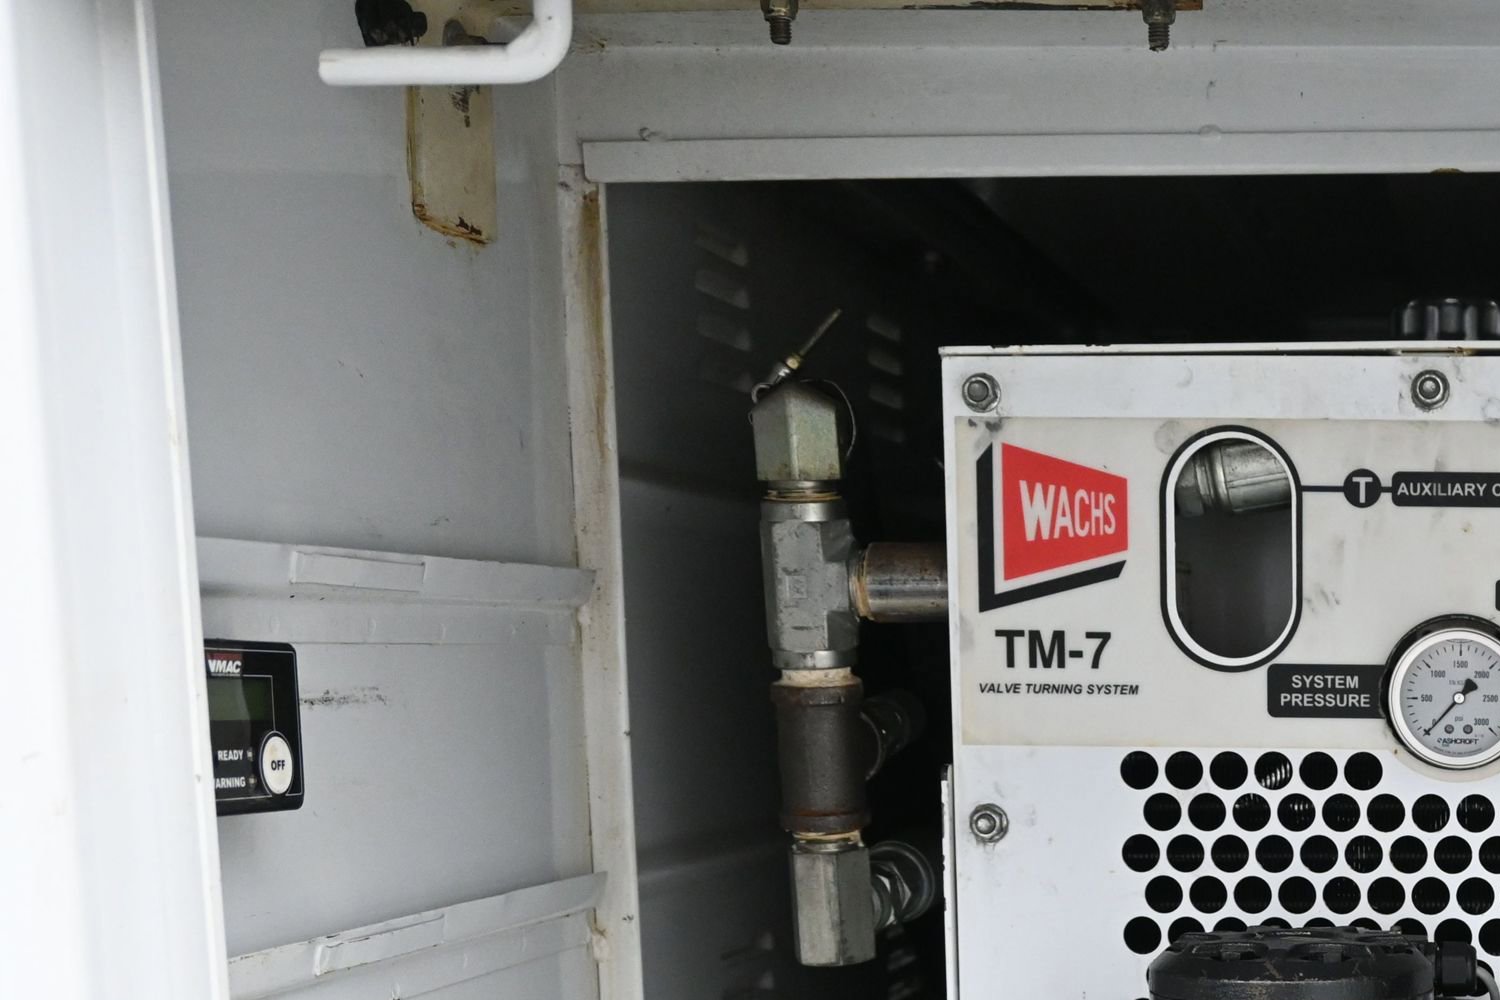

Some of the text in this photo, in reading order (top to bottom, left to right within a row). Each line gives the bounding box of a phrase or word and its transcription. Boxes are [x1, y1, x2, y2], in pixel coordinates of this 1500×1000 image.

[1351, 476, 1373, 503] T
[1397, 481, 1487, 497] AUXILIARY
[1019, 479, 1116, 542] WACHS
[995, 629, 1111, 669] TM-7
[1453, 660, 1468, 669] 1500
[1430, 670, 1446, 678] 1000
[1474, 670, 1490, 679] 2000
[1291, 674, 1359, 689] SYSTEM
[979, 683, 1139, 695] VALVE TURNING SYSTEM
[1280, 693, 1371, 707] PRESSURE
[1420, 694, 1433, 703] 500
[1482, 694, 1499, 703] 2500
[1474, 718, 1490, 726] 3000
[217, 750, 244, 761] READY
[270, 760, 285, 771] OFF
[215, 776, 246, 788] ARNING
